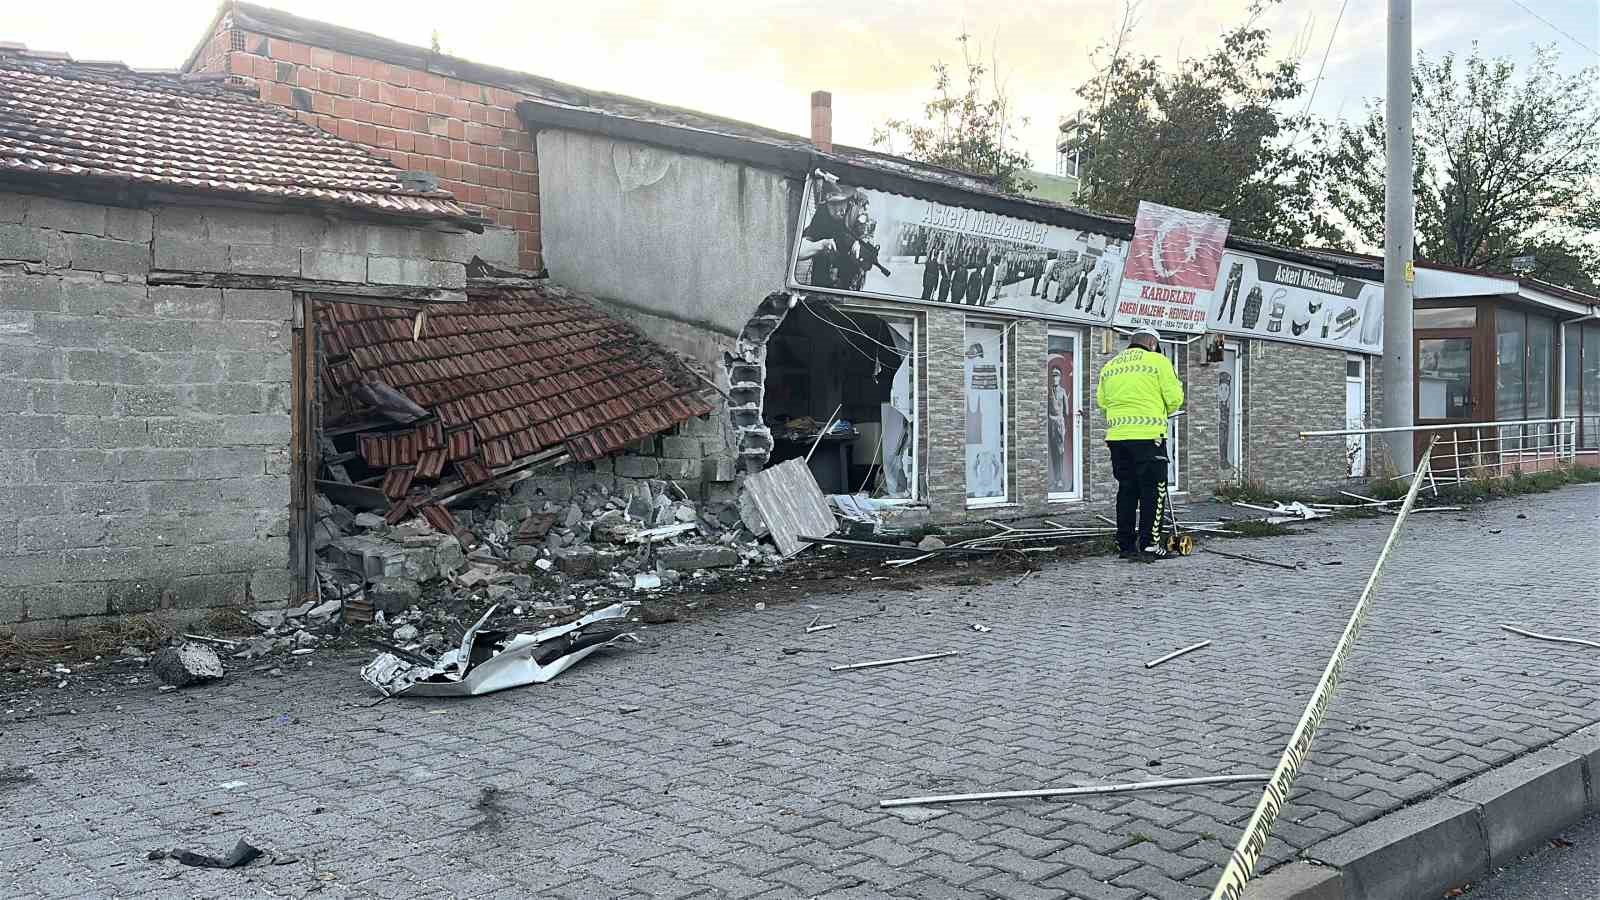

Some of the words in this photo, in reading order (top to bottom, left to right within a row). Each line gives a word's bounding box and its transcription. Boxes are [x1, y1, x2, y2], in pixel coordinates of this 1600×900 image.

[920, 202, 968, 231] Askeri
[966, 209, 1048, 243] Malzemeler
[1275, 264, 1302, 285] Askeri
[1301, 269, 1345, 294] Malzemeler
[1141, 286, 1196, 304] KARDELEN
[1139, 303, 1165, 317] MALZEME
